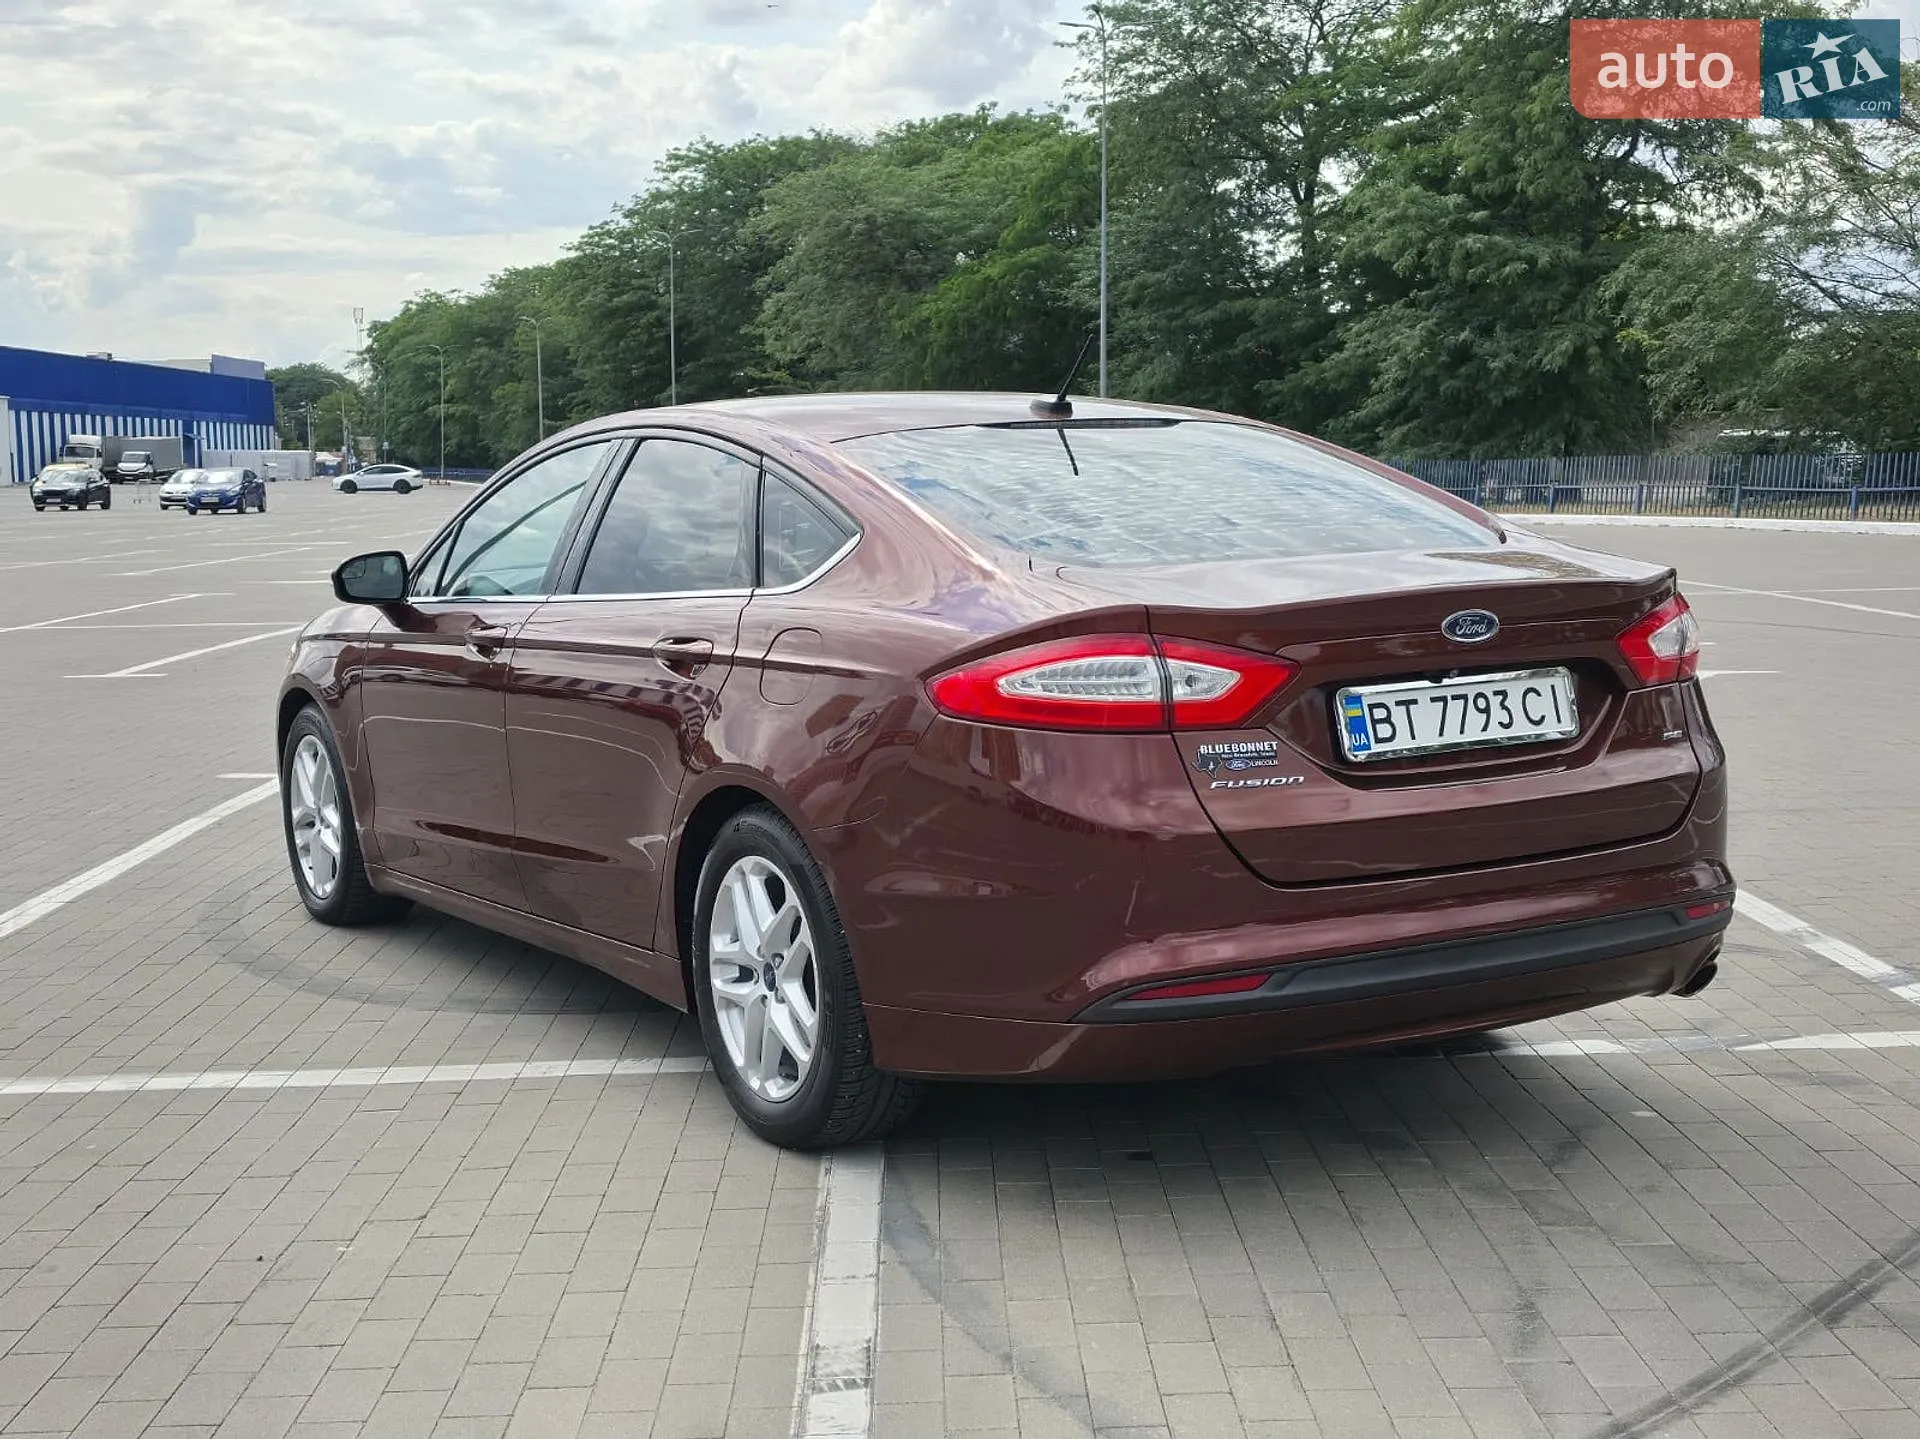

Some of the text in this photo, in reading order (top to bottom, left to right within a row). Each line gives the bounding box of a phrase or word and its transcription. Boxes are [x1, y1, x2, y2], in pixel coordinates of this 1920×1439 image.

[1456, 616, 1488, 635] Ford
[1367, 684, 1562, 744] BT 7793 CI
[1200, 741, 1278, 754] BLUEBONNET
[1352, 735, 1368, 746] UA
[1210, 776, 1304, 790] FUSION
